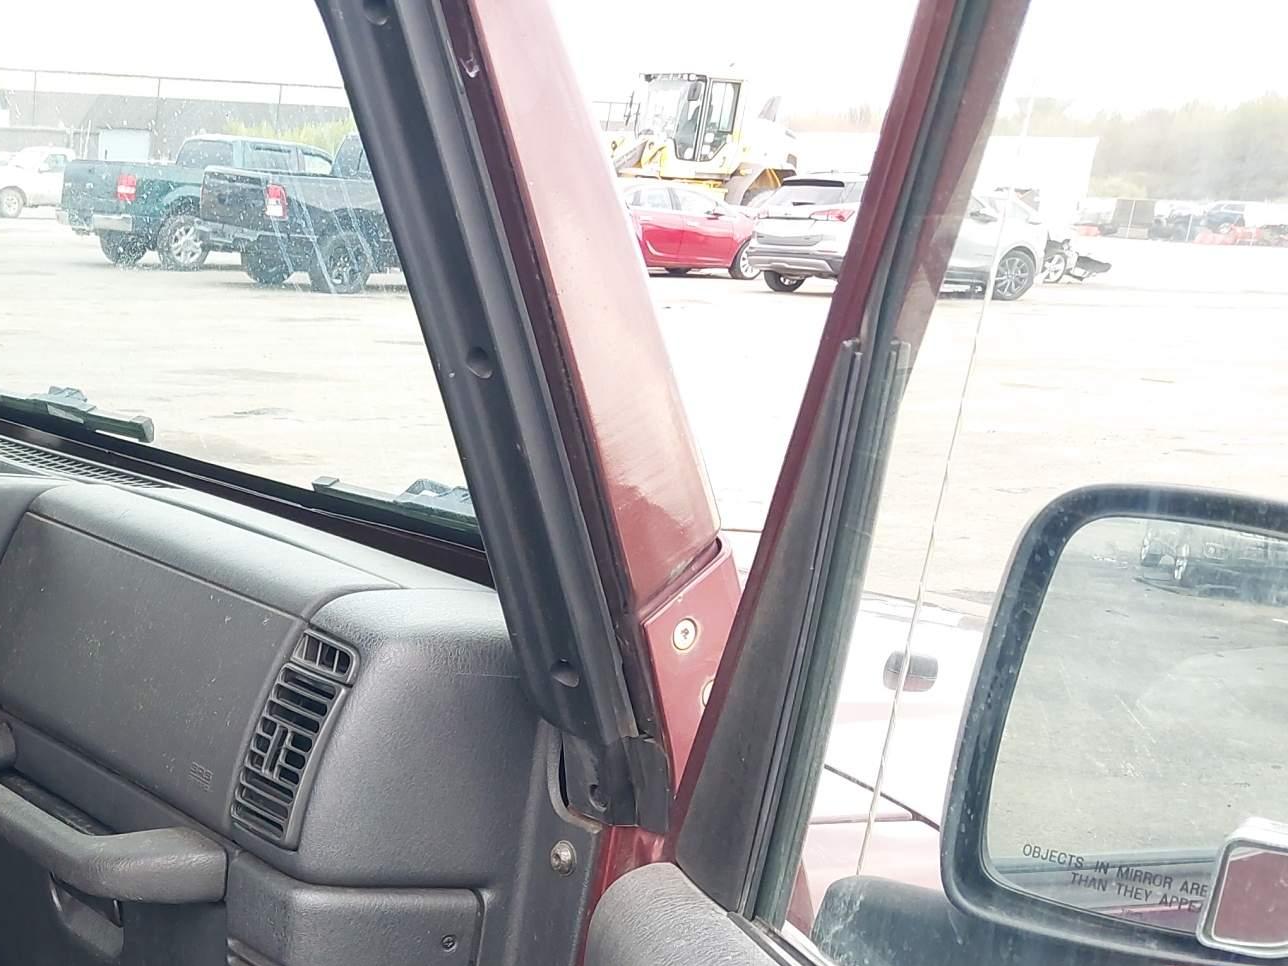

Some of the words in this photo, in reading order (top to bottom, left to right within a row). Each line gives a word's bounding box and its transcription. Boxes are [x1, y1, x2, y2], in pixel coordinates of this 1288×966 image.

[1022, 843, 1085, 869] OBJECTS
[1094, 860, 1110, 875] IN
[1116, 866, 1173, 890] MIRROR
[1179, 880, 1209, 898] ARE
[1071, 872, 1107, 892] THAN
[1116, 883, 1152, 902] THEY
[1158, 893, 1203, 914] APPE
